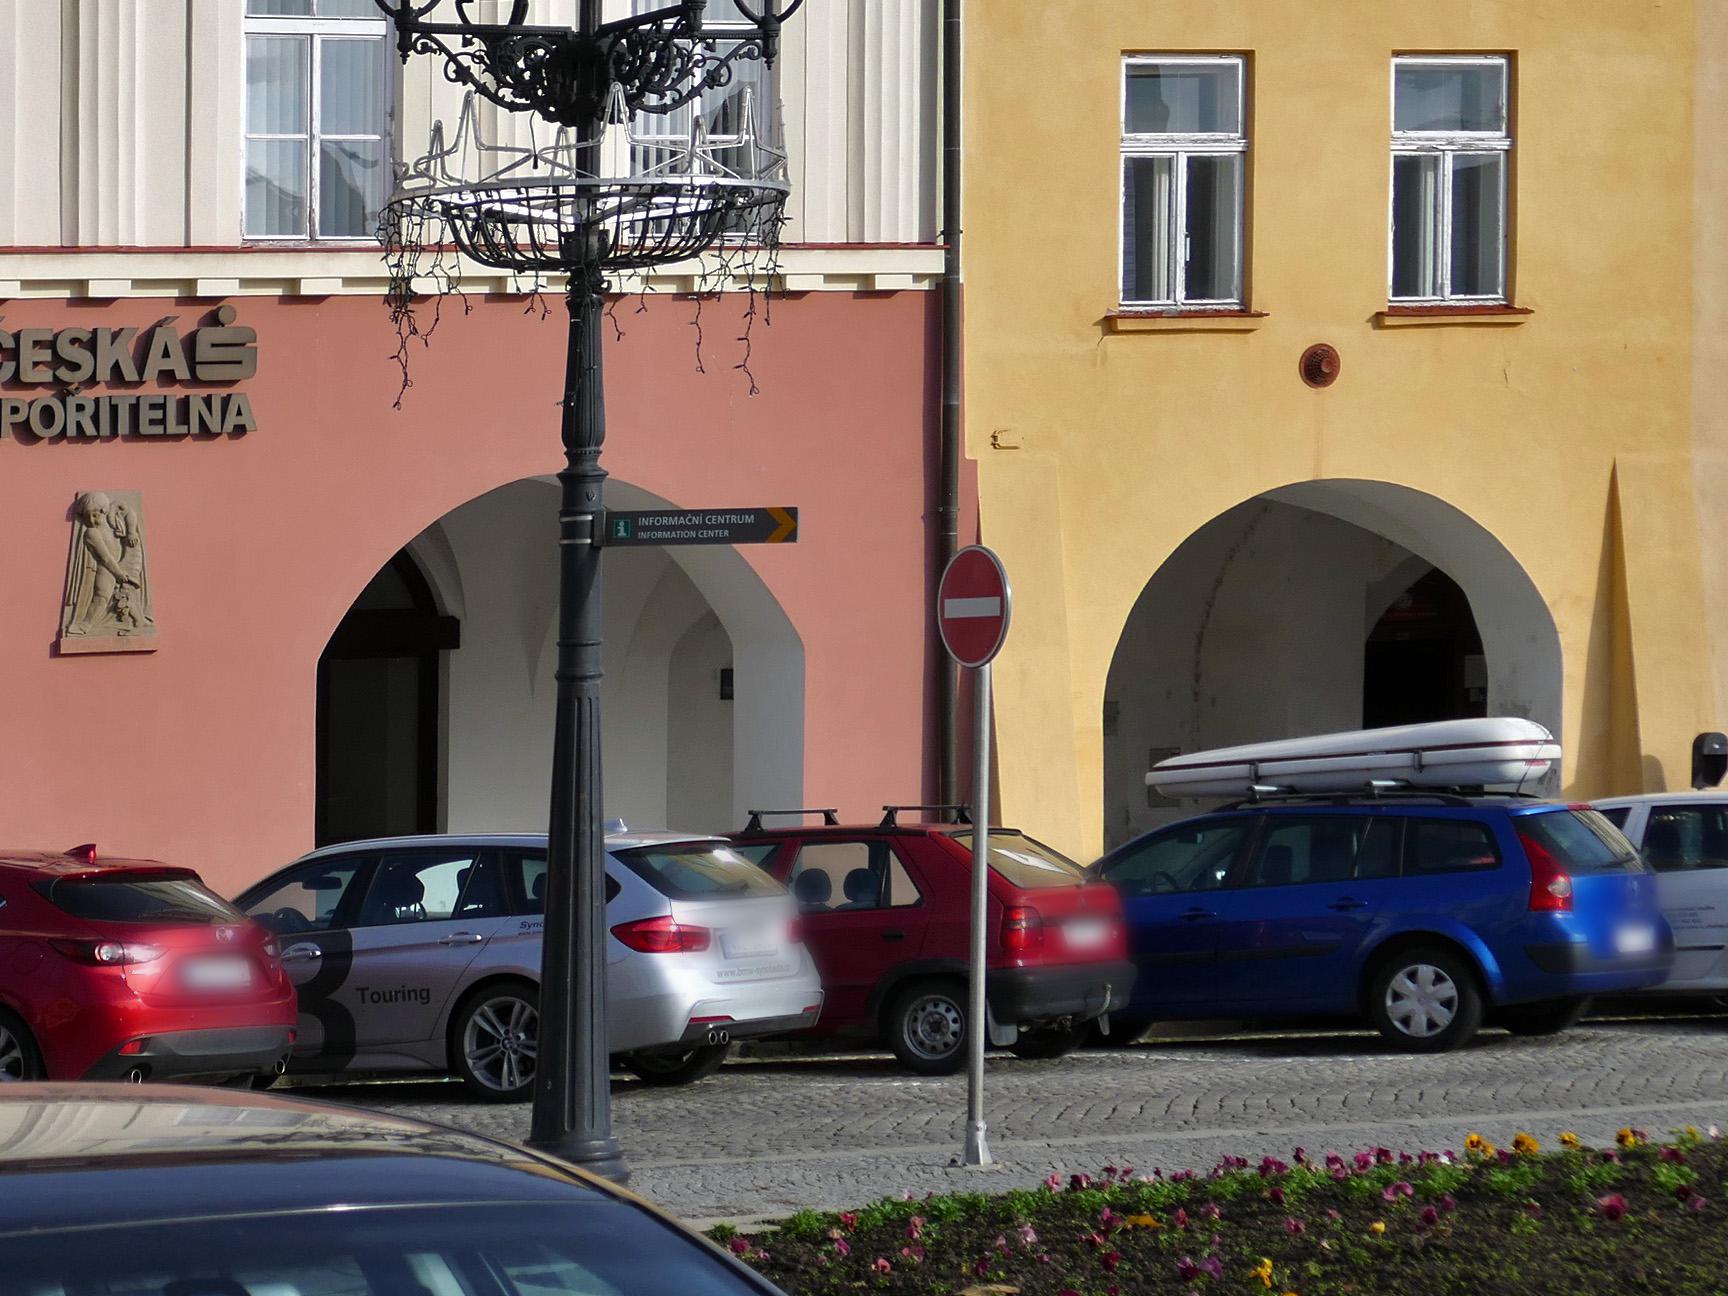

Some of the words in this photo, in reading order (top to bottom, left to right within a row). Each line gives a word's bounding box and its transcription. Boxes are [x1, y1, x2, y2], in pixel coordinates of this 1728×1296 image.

[638, 514, 703, 526] INFORMAČNÍ
[705, 514, 754, 525] CENTRUM
[638, 531, 696, 539] INFORMATION
[698, 529, 729, 537] CENTER
[356, 985, 430, 1005] Touring
